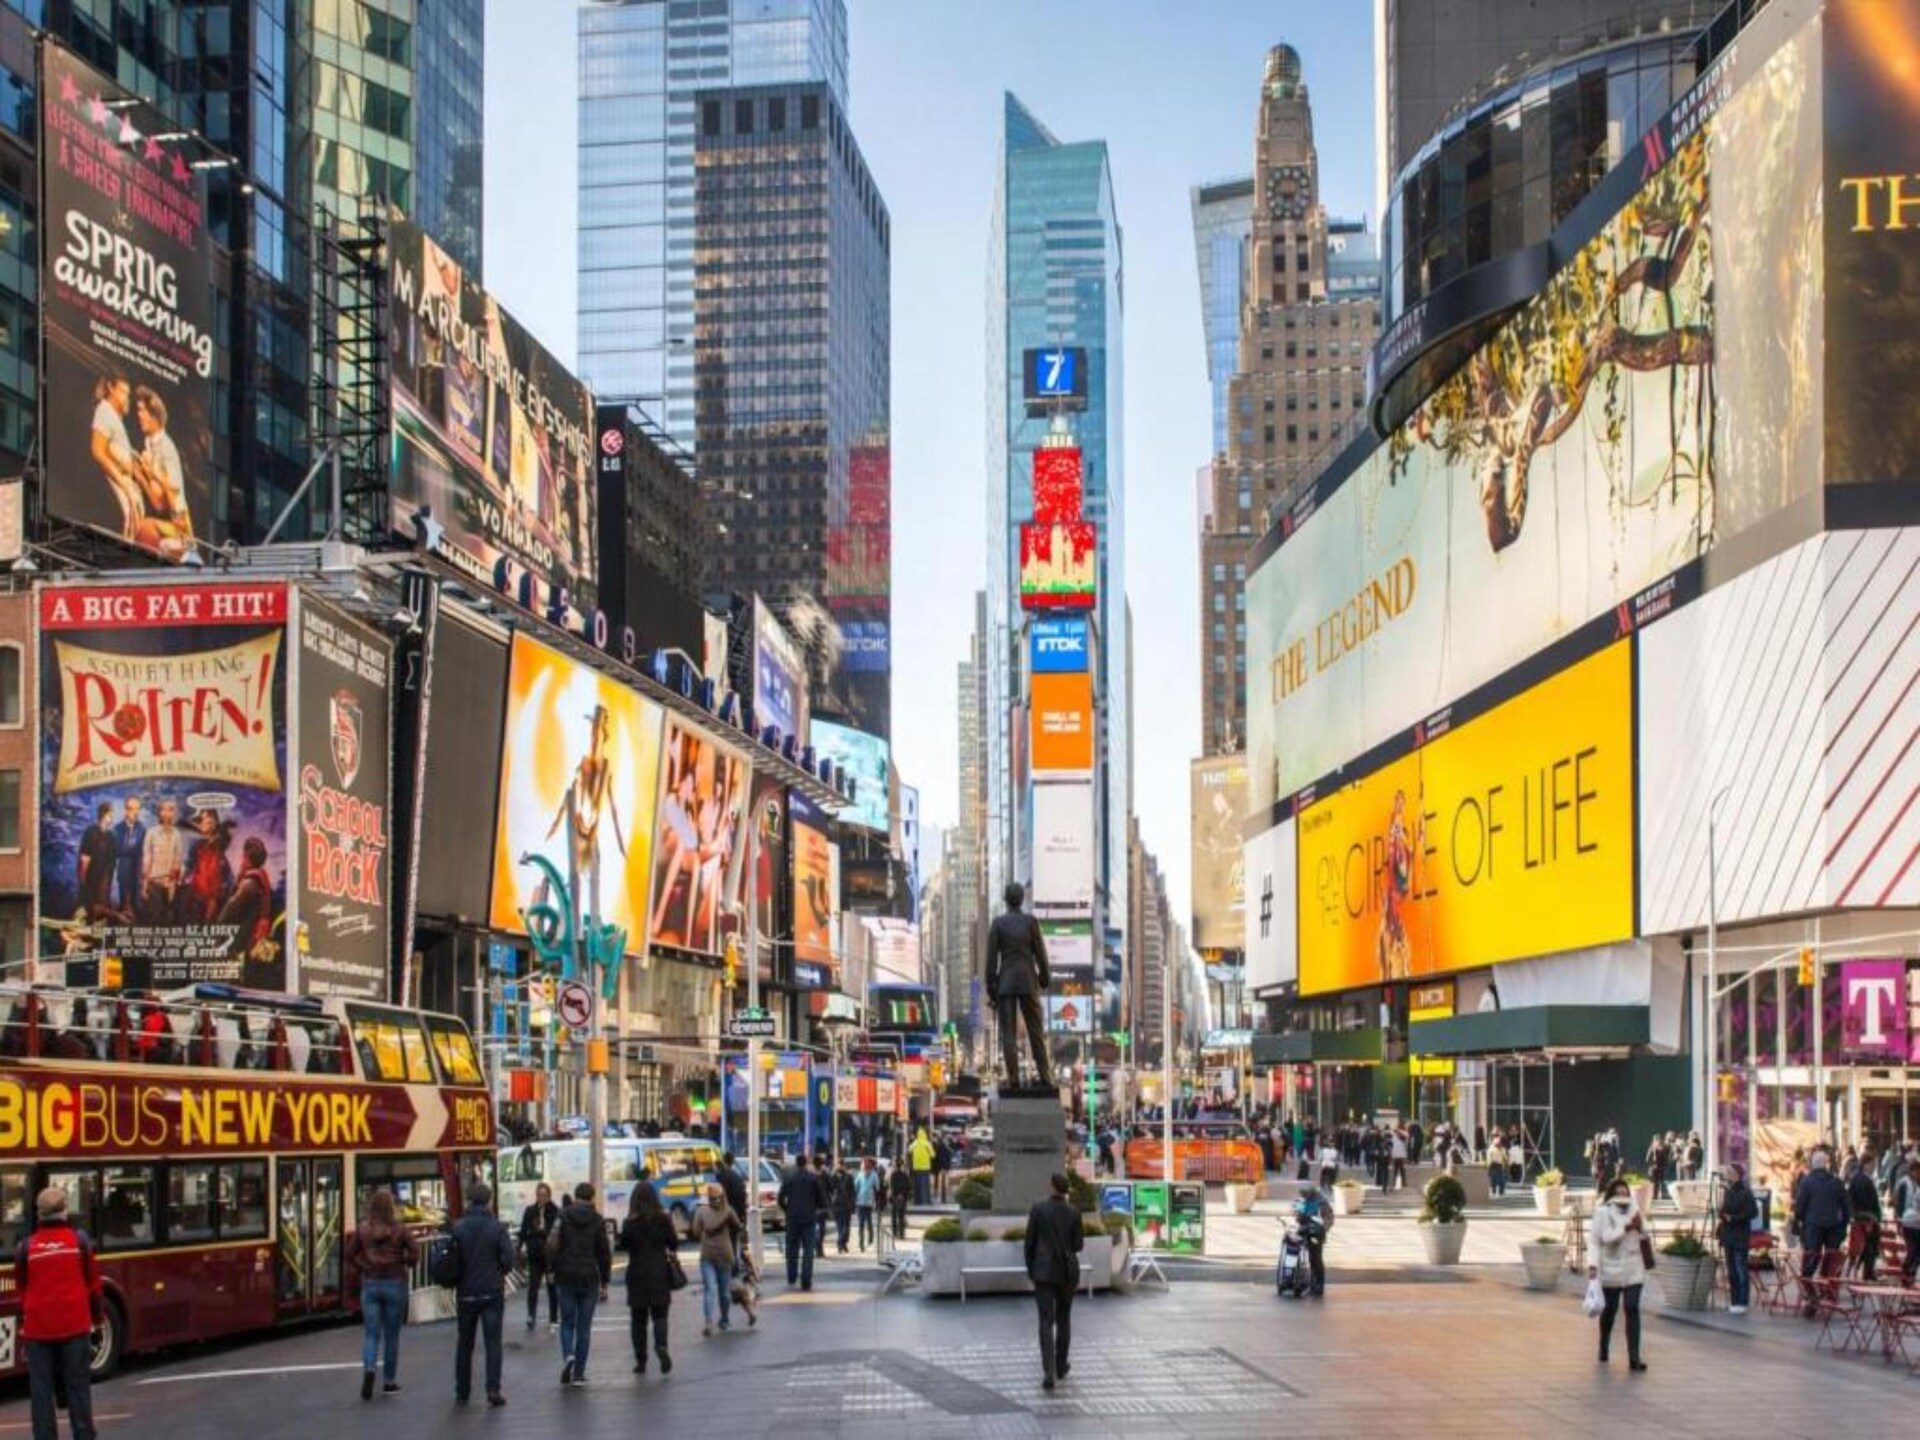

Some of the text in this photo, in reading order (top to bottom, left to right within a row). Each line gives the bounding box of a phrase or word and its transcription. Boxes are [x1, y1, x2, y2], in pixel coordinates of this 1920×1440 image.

[1045, 354, 1065, 389] 7
[51, 591, 274, 622] A BIG FAT HIT!
[1270, 557, 1416, 706] THE LEGEND
[66, 652, 272, 771] ROTTEN!
[301, 763, 386, 848] SCHOOL
[1344, 746, 1598, 919] CIRLE OF LIFE
[308, 830, 382, 905] ROCK
[1848, 977, 1896, 1045] T
[181, 1088, 274, 1146] NEW
[285, 1091, 373, 1145] YORK
